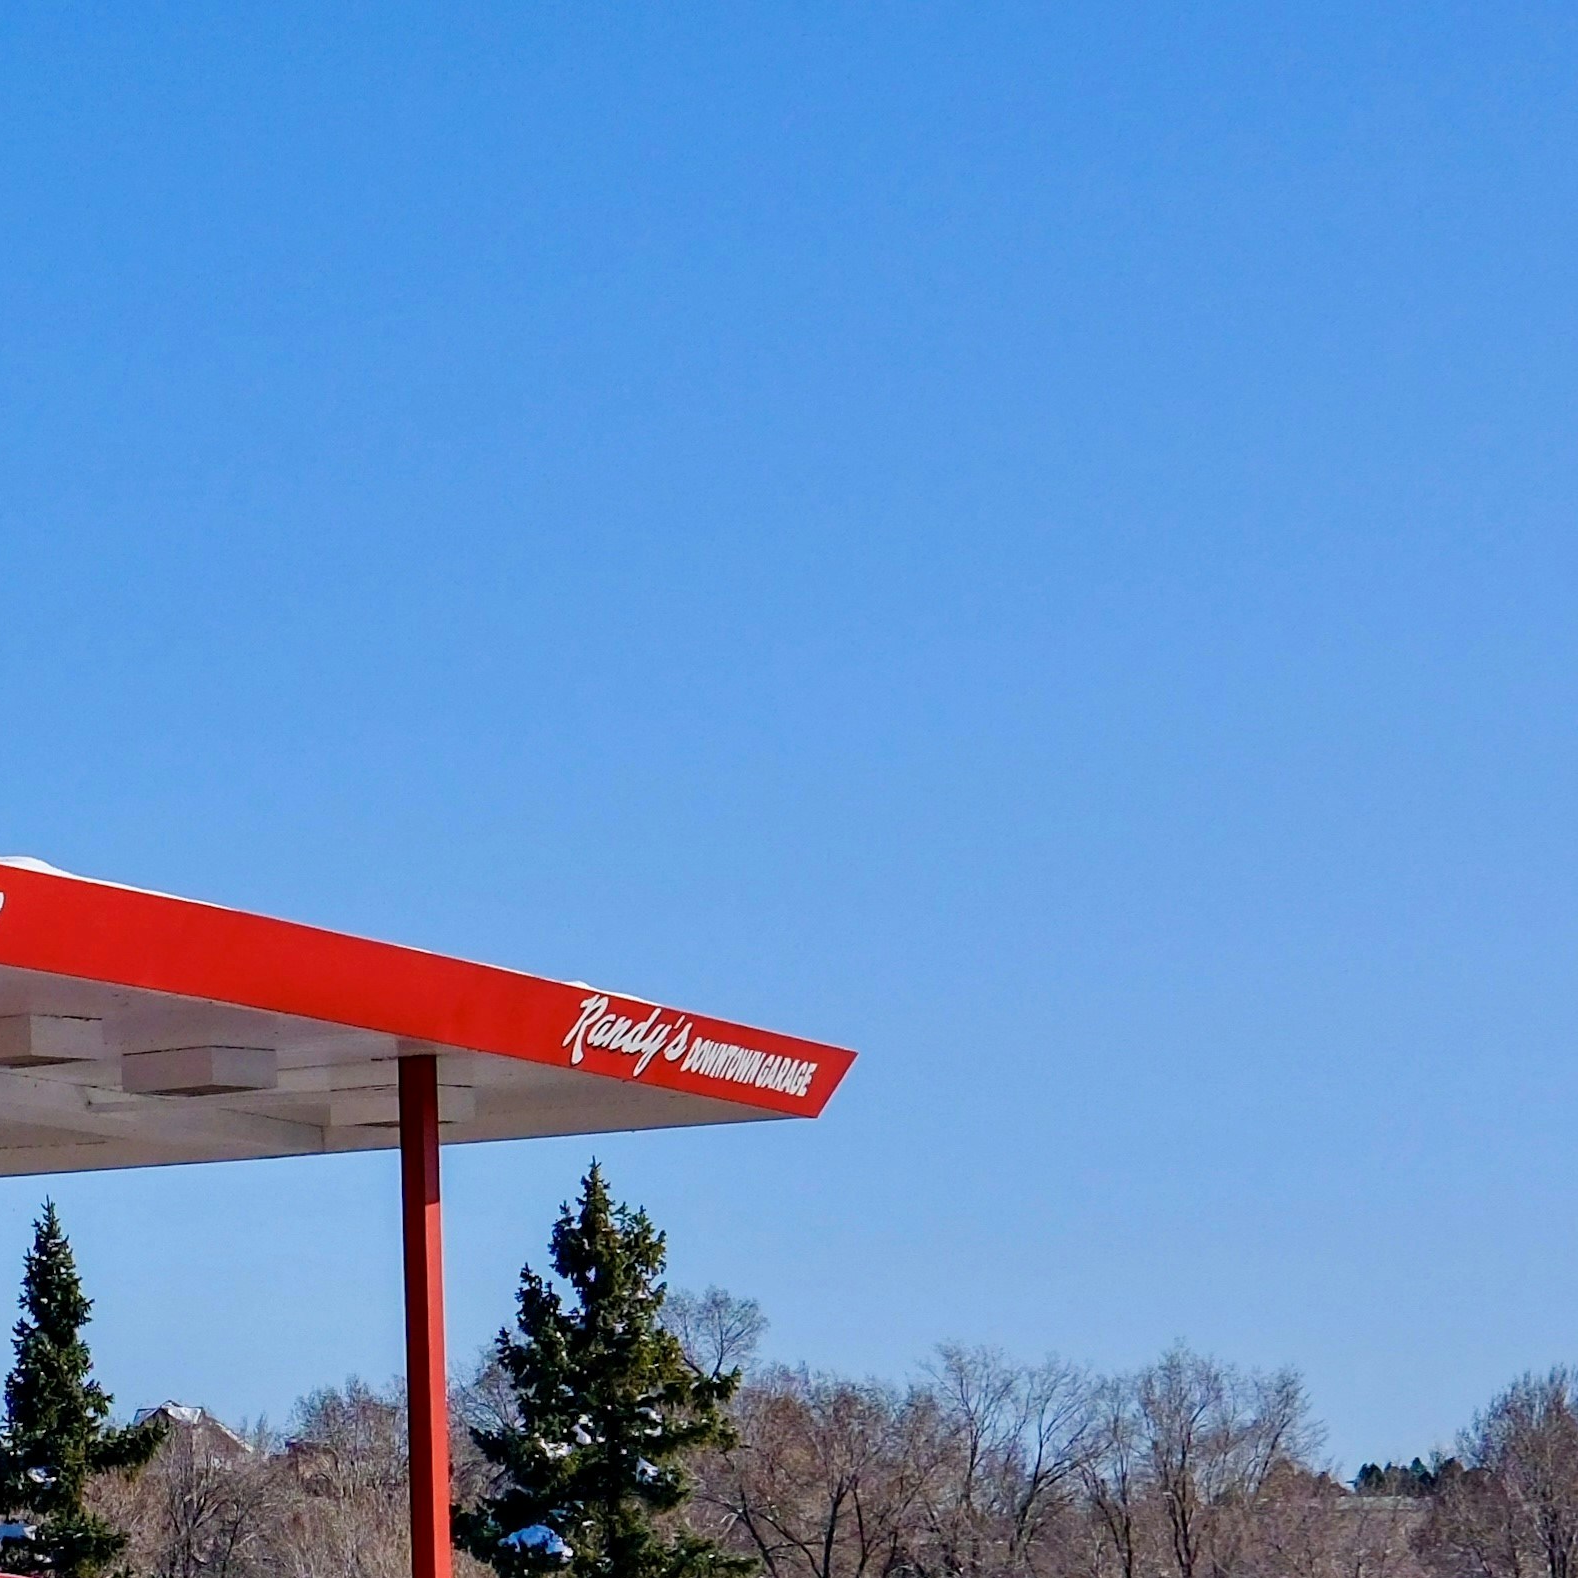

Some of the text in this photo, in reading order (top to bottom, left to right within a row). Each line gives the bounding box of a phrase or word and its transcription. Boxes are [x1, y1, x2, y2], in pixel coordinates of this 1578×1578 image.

[562, 993, 819, 1098] Randy's DOWNTOWN GARAGE
